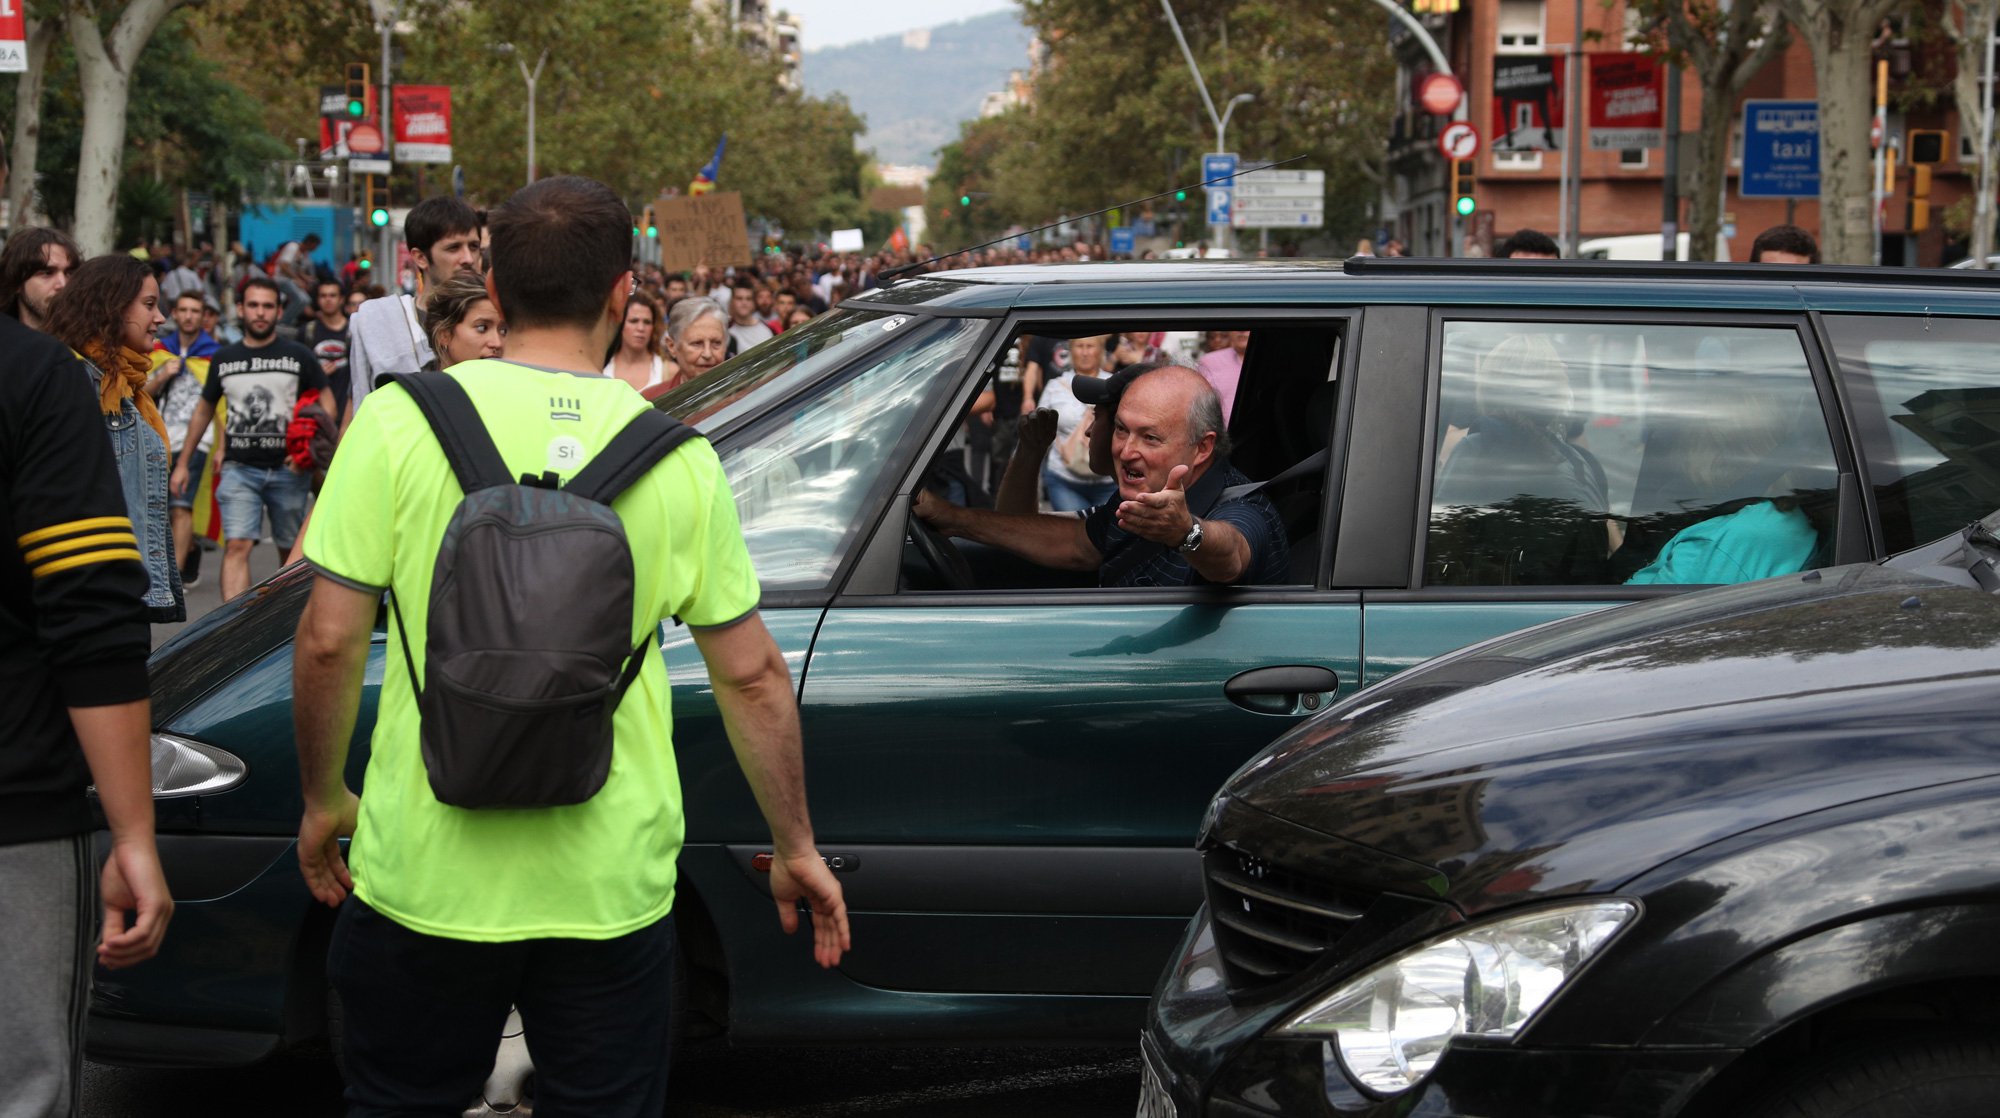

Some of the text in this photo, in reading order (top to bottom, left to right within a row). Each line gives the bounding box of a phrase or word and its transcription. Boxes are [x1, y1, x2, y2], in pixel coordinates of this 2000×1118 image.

[1772, 139, 1812, 158] taxi
[1213, 191, 1228, 210] P
[218, 359, 249, 377] Dave
